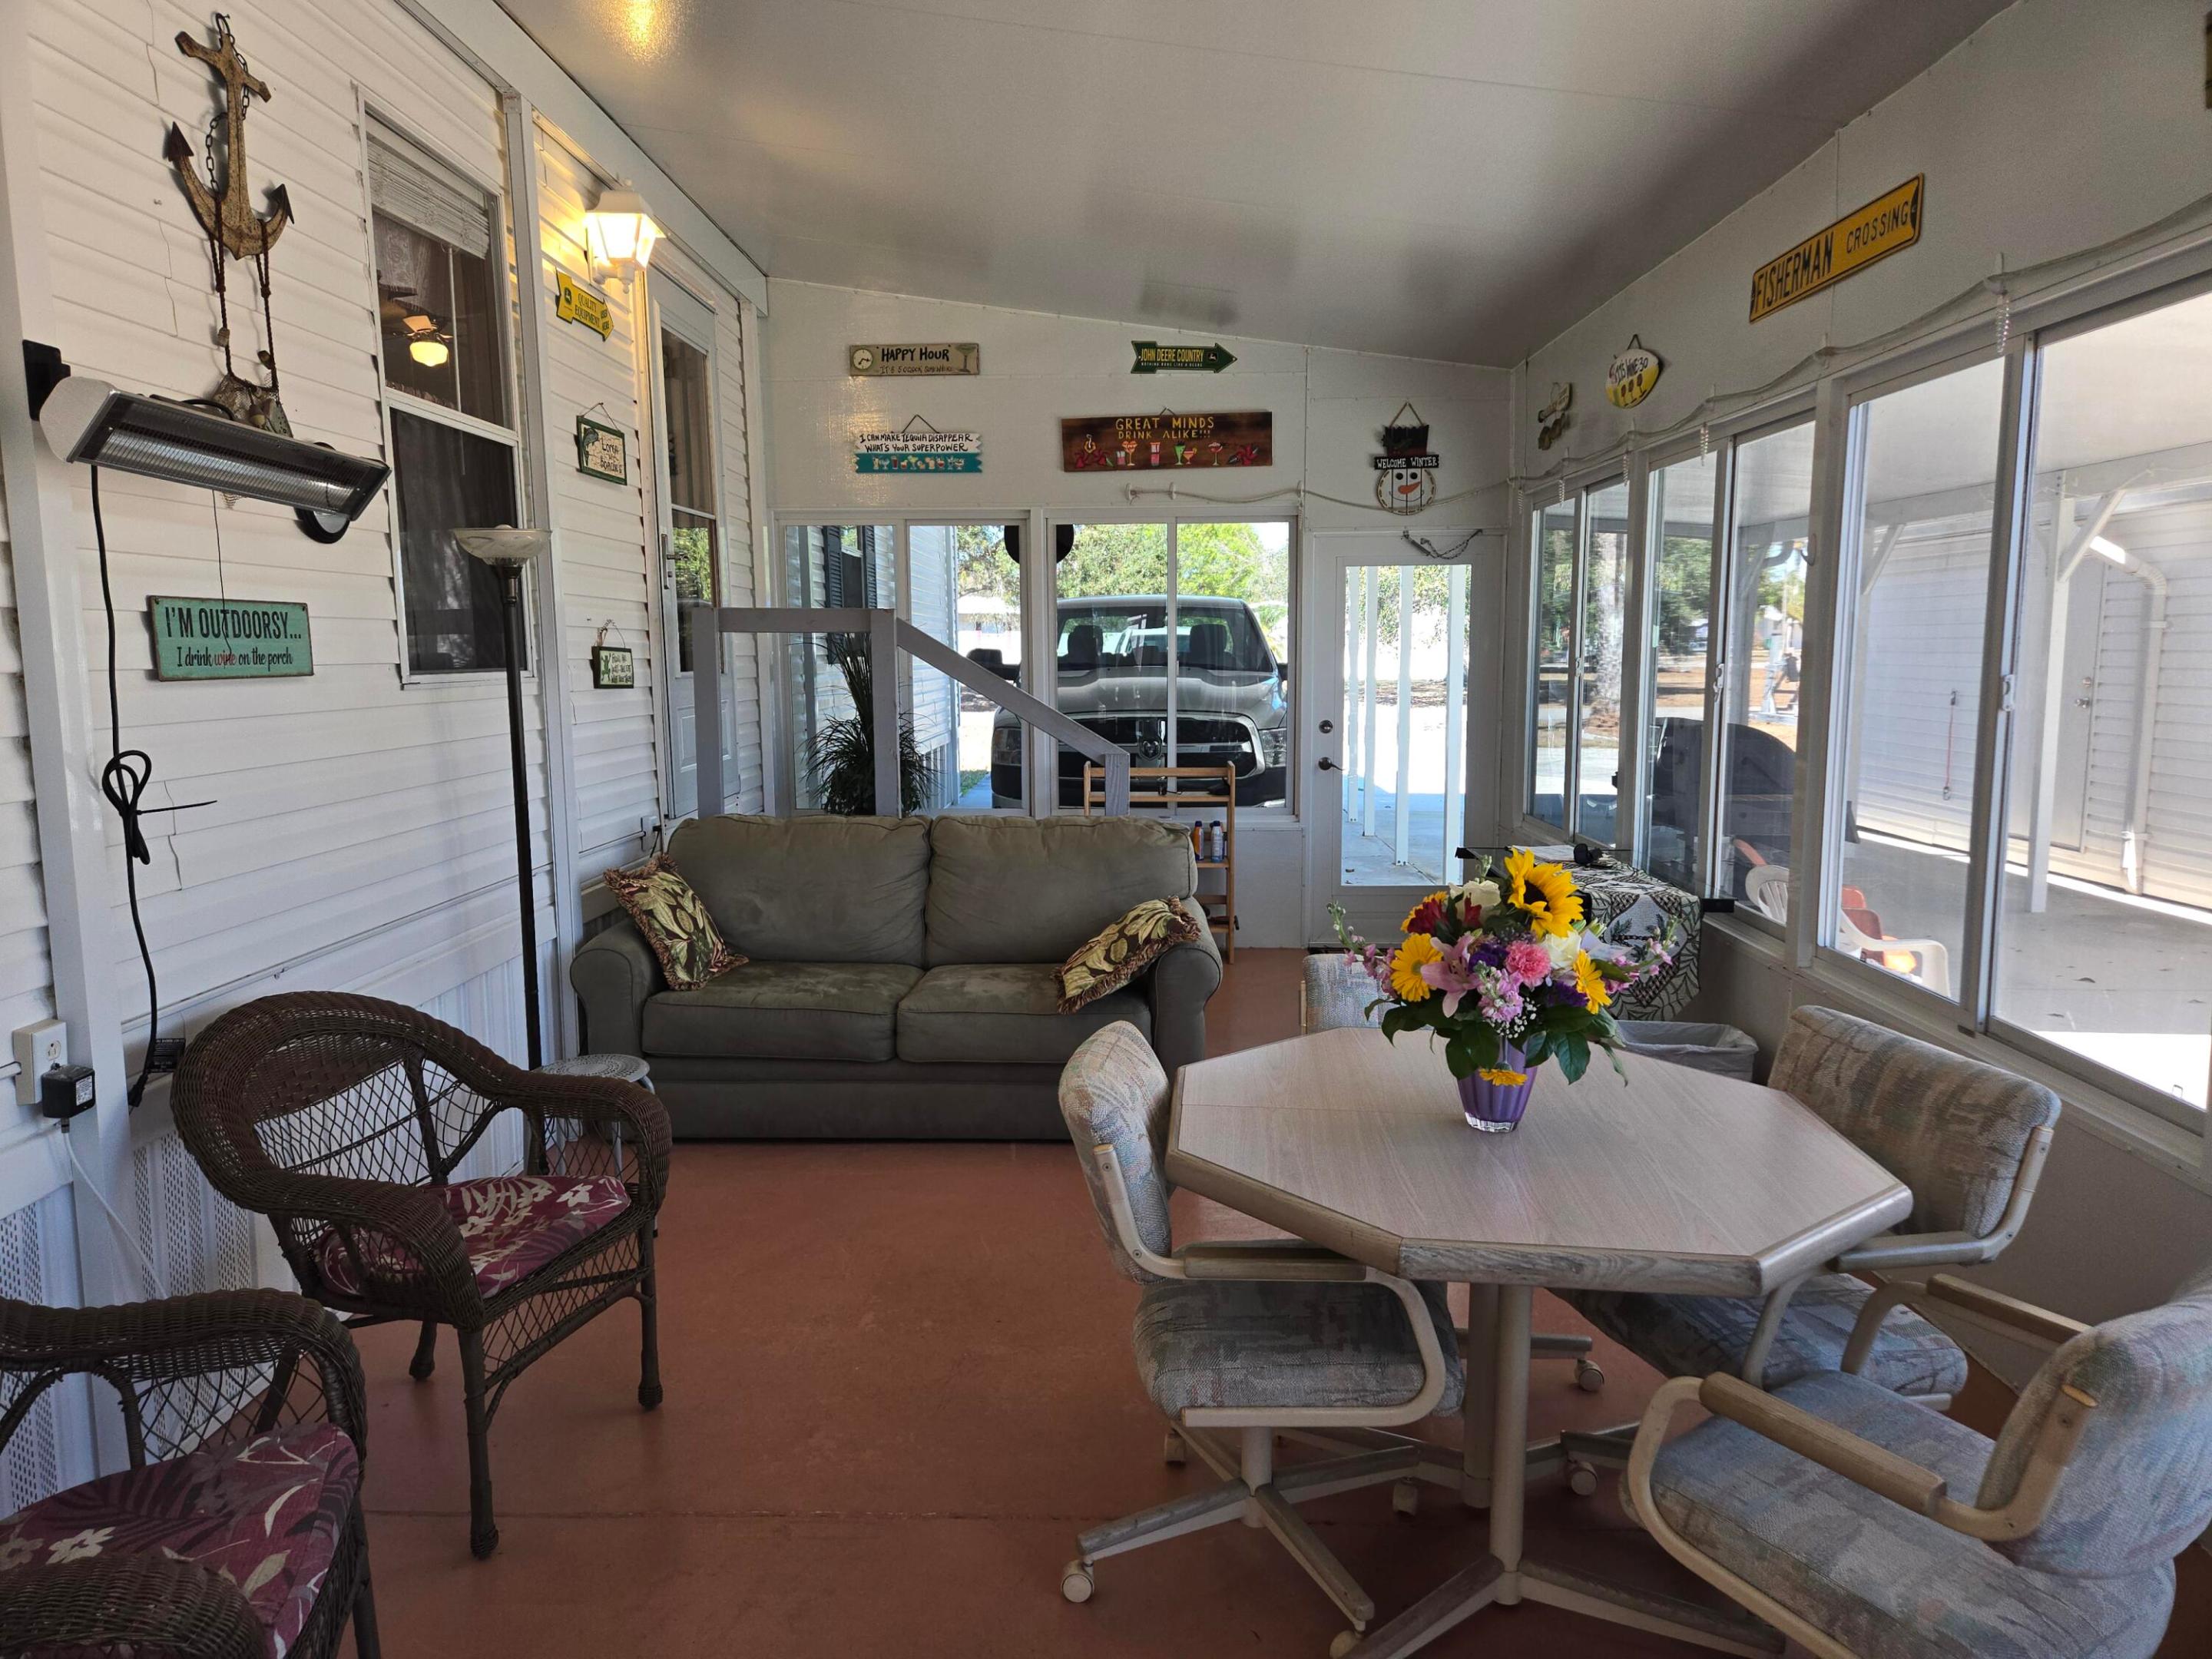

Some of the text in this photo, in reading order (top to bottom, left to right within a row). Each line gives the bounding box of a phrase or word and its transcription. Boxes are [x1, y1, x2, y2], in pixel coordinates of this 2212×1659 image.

[1754, 200, 1909, 313] FISHERMAN CROSSING
[881, 346, 950, 363] HAPPY HOUR
[1141, 348, 1204, 363] JOHN DEERE COUNTRY
[1115, 416, 1214, 430] GREAT MINDS
[859, 432, 973, 443] I CAN MAKE TEQUILA DISAPPEAR
[1118, 429, 1211, 440] DRINK ALIKE!!!
[864, 442, 969, 452] WHAT'S YOUR SUPERPOWER
[1376, 456, 1437, 468] WELCOME WINTER
[165, 606, 302, 639] I'M OUTDOORSY...
[177, 647, 182, 667] I
[184, 647, 213, 667] drink
[238, 653, 250, 665] on
[251, 647, 267, 665] the
[267, 647, 293, 671] porch
